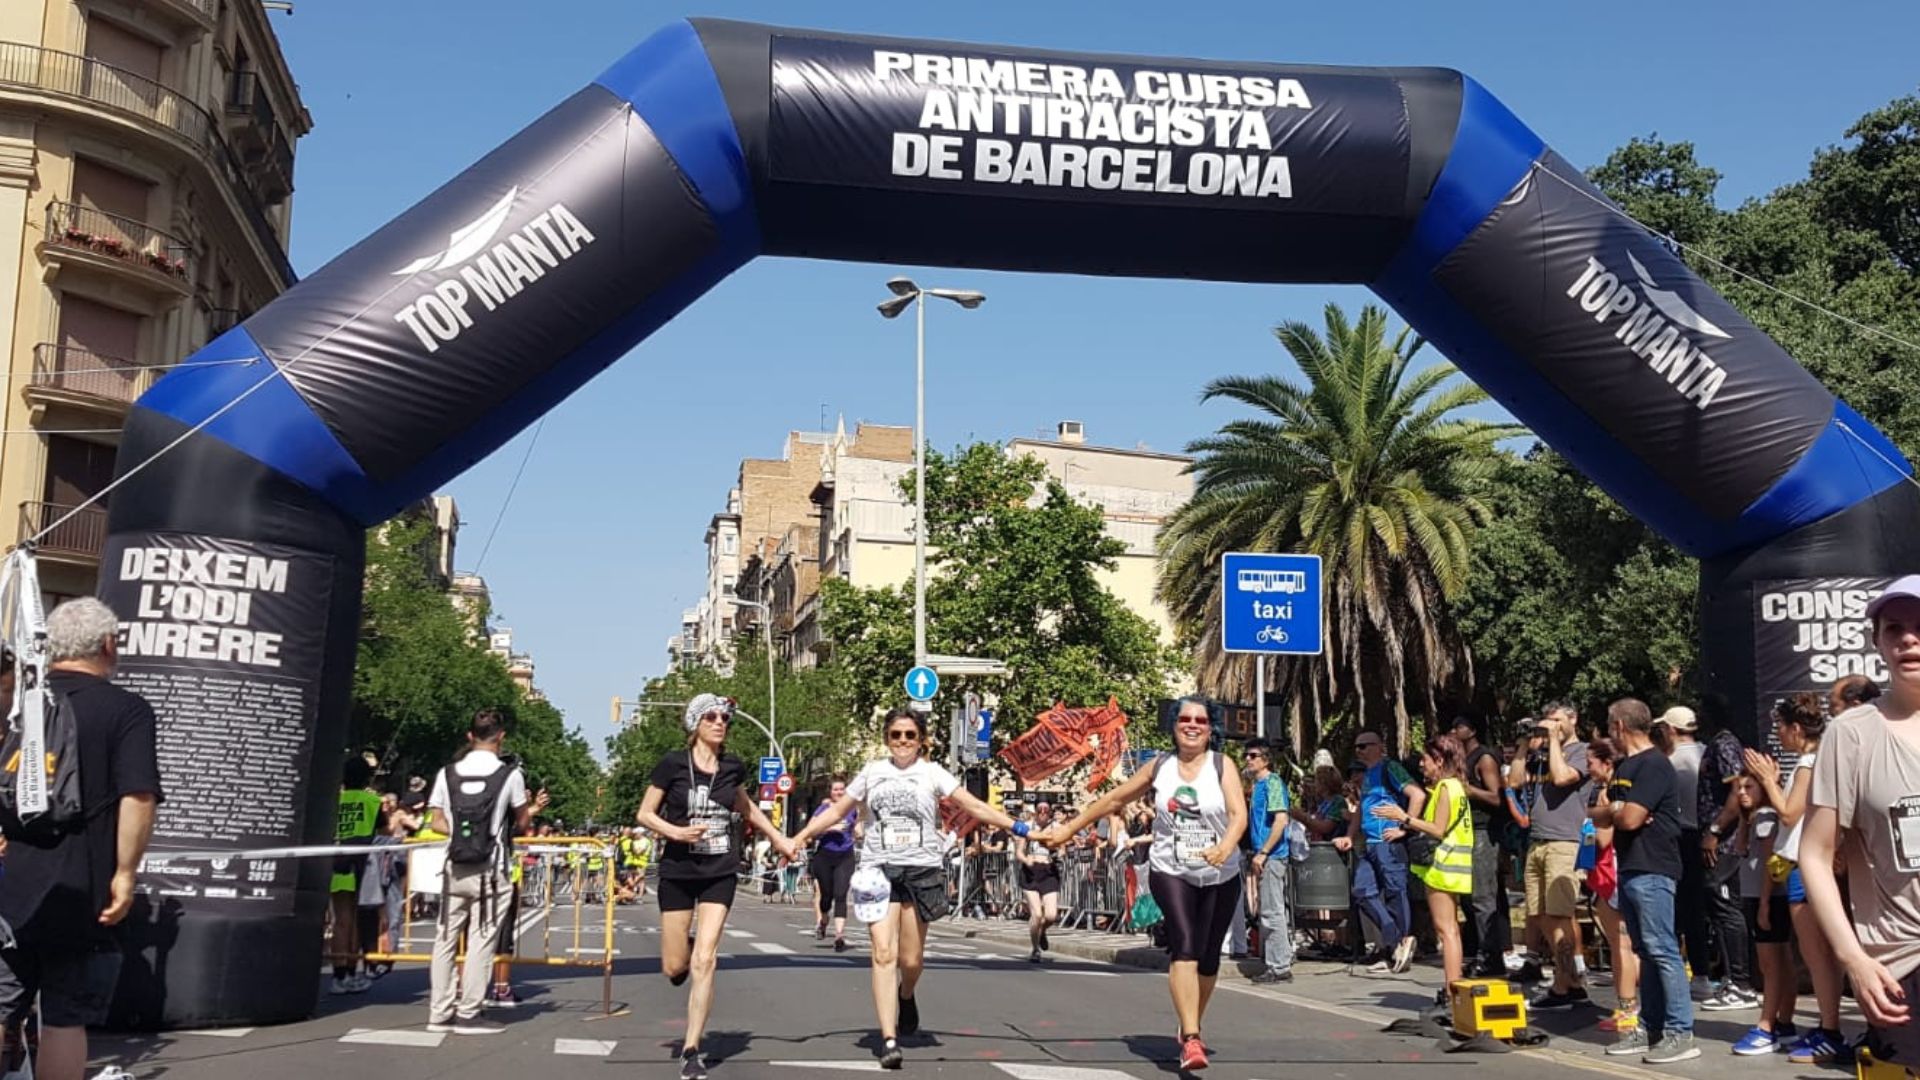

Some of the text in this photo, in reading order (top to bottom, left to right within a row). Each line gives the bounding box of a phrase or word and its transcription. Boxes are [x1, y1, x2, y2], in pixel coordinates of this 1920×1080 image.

[873, 50, 1312, 109] PRIMERA CURSA
[918, 90, 1272, 150] ANTIRACISTA
[891, 132, 1293, 198] DE BARCELONA
[393, 202, 597, 354] TOP MANTA
[1566, 255, 1728, 411] TOP MANTA
[119, 547, 289, 593] DEIXEM
[137, 584, 252, 626] L'ODI
[1252, 600, 1292, 619] taxi
[117, 622, 283, 667] ENRERE
[1793, 622, 1876, 652] JUS
[1809, 653, 1892, 683] SOC
